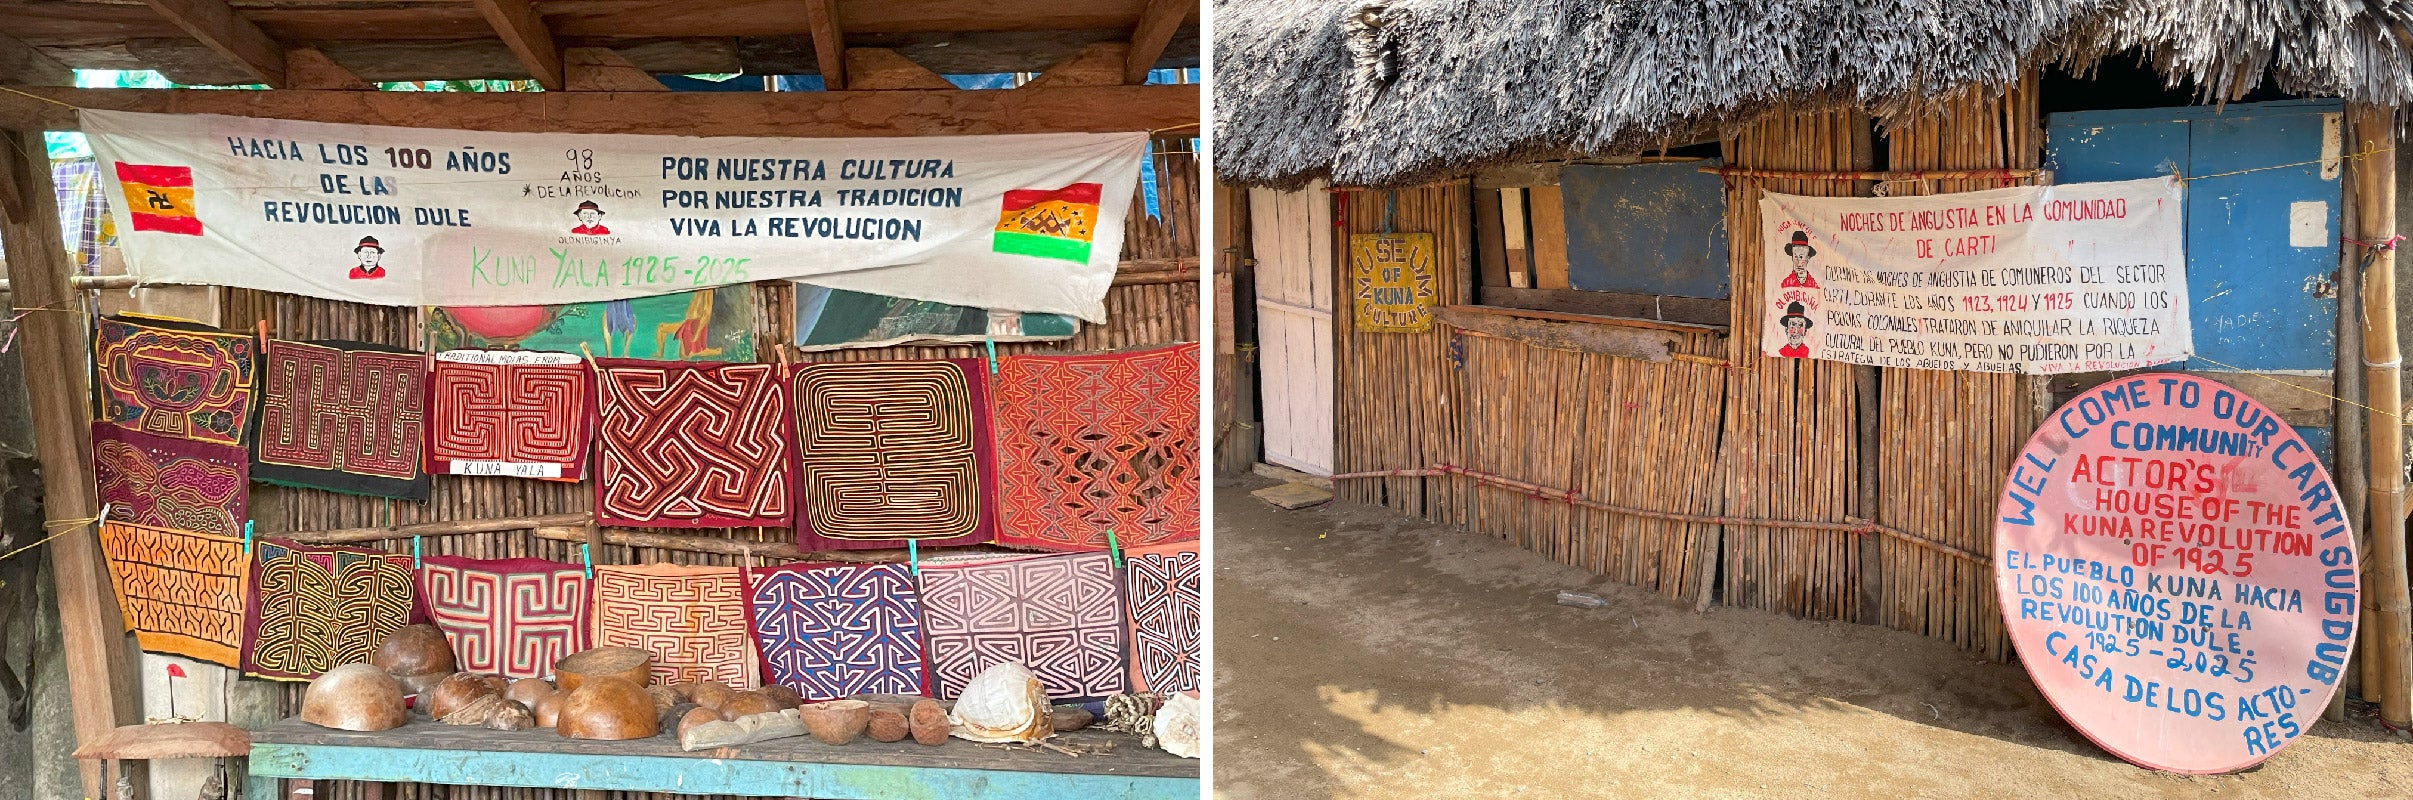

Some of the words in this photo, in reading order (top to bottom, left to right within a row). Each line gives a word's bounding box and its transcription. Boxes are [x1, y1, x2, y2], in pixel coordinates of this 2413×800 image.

[228, 137, 304, 162] HACIA
[318, 144, 368, 166] LOS
[384, 148, 432, 169] 100
[446, 146, 511, 174] AÑOS
[566, 149, 593, 171] 98
[662, 156, 709, 181] POR
[717, 158, 826, 181] NUESTRA
[840, 159, 954, 181] CULTURA
[320, 174, 351, 195] DE
[560, 171, 602, 183] AÑOS
[537, 186, 556, 199] DE
[560, 186, 572, 198] LA
[662, 190, 709, 208] POR
[716, 190, 822, 209] NUESTRA
[837, 187, 963, 208] TRADICION
[264, 201, 401, 225] REVOLUCION
[415, 207, 472, 227] DULE
[1840, 212, 1884, 232] NOCHES
[1890, 211, 1905, 231] DE
[1911, 207, 1979, 231] ANGUSTIA
[1986, 204, 2006, 226] EN
[2013, 202, 2033, 223] LA
[2043, 198, 2127, 221] COMUNIDAD
[669, 218, 721, 237] VIVA
[731, 218, 758, 237] LA
[768, 217, 922, 242] REVOLUCION
[1916, 239, 1934, 259] DE
[1945, 235, 1995, 257] CARTI
[472, 246, 537, 288] KUNA
[549, 247, 609, 288] YALA
[1356, 239, 1433, 299] MUSEUM
[1382, 267, 1400, 283] OF
[1912, 271, 1924, 288] DE
[1927, 270, 1977, 288] ANGUSTIA
[1982, 270, 1997, 287] DE
[2001, 266, 2072, 287] COMUNEROS
[2080, 266, 2106, 284] DEL
[2116, 264, 2166, 284] SECTOR
[1373, 287, 1413, 305] KUNA
[1854, 290, 1899, 309] DURANTE
[1903, 294, 1923, 310] LOS
[1927, 292, 1955, 312] AÑOS
[1962, 294, 1994, 313] 1923,
[1997, 294, 2028, 312] 1924
[2032, 293, 2041, 311] Y
[2043, 291, 2074, 311] 1925
[2083, 291, 2136, 311] CUANDO
[2144, 290, 2168, 309] LOS
[1363, 302, 1427, 327] CULTURE
[1922, 317, 1977, 336] TRATARON
[1981, 320, 1998, 336] DE
[2003, 318, 2072, 337] ANIQUILAR
[2080, 320, 2095, 336] LA
[2103, 317, 2160, 337] RIQUEZA
[1825, 332, 1864, 352] CULTURAL
[1869, 336, 1885, 353] DEL
[1965, 343, 1993, 360] PERO
[1998, 344, 2013, 360] NO
[2020, 342, 2078, 361] PUDIERON
[2085, 343, 2113, 360] POR
[2120, 342, 2135, 360] LA
[535, 356, 561, 364] FROM
[1895, 357, 1910, 368] LOS
[1963, 361, 1970, 370] Y
[2040, 362, 2064, 373] VIVA
[2158, 379, 2200, 409] TO
[2213, 389, 2279, 447] OUR
[2111, 420, 2264, 459] COMMUNITY
[464, 463, 501, 475] KUNA
[516, 464, 544, 476] YALA
[2071, 453, 2216, 494] ACTOR'S
[2271, 438, 2345, 541] CARTI
[2095, 488, 2194, 519] HOUSE
[2202, 497, 2240, 522] OF
[2247, 501, 2300, 530] THE
[2063, 512, 2134, 539] KUNA
[2140, 518, 2313, 557] REVOLUTION
[2132, 542, 2167, 568] OF
[2172, 547, 2254, 577] 1925
[2007, 550, 2037, 569] EL
[2043, 553, 2134, 587] PUEBLO
[2147, 572, 2222, 601] KUNA
[2235, 583, 2303, 613] HACIA
[2016, 573, 2064, 600] LOS
[2073, 581, 2103, 605] 100
[2107, 588, 2171, 621] AÑOS
[2179, 601, 2215, 628] DE
[2221, 608, 2252, 631] LA
[2021, 598, 2164, 642] REVOLUTION
[2306, 545, 2356, 686] SUGDUB
[2085, 631, 2140, 657] 1925
[2045, 631, 2113, 693] CASA
[2122, 674, 2160, 708] DE
[2167, 687, 2226, 722] LOS
[2243, 712, 2299, 756] RES
